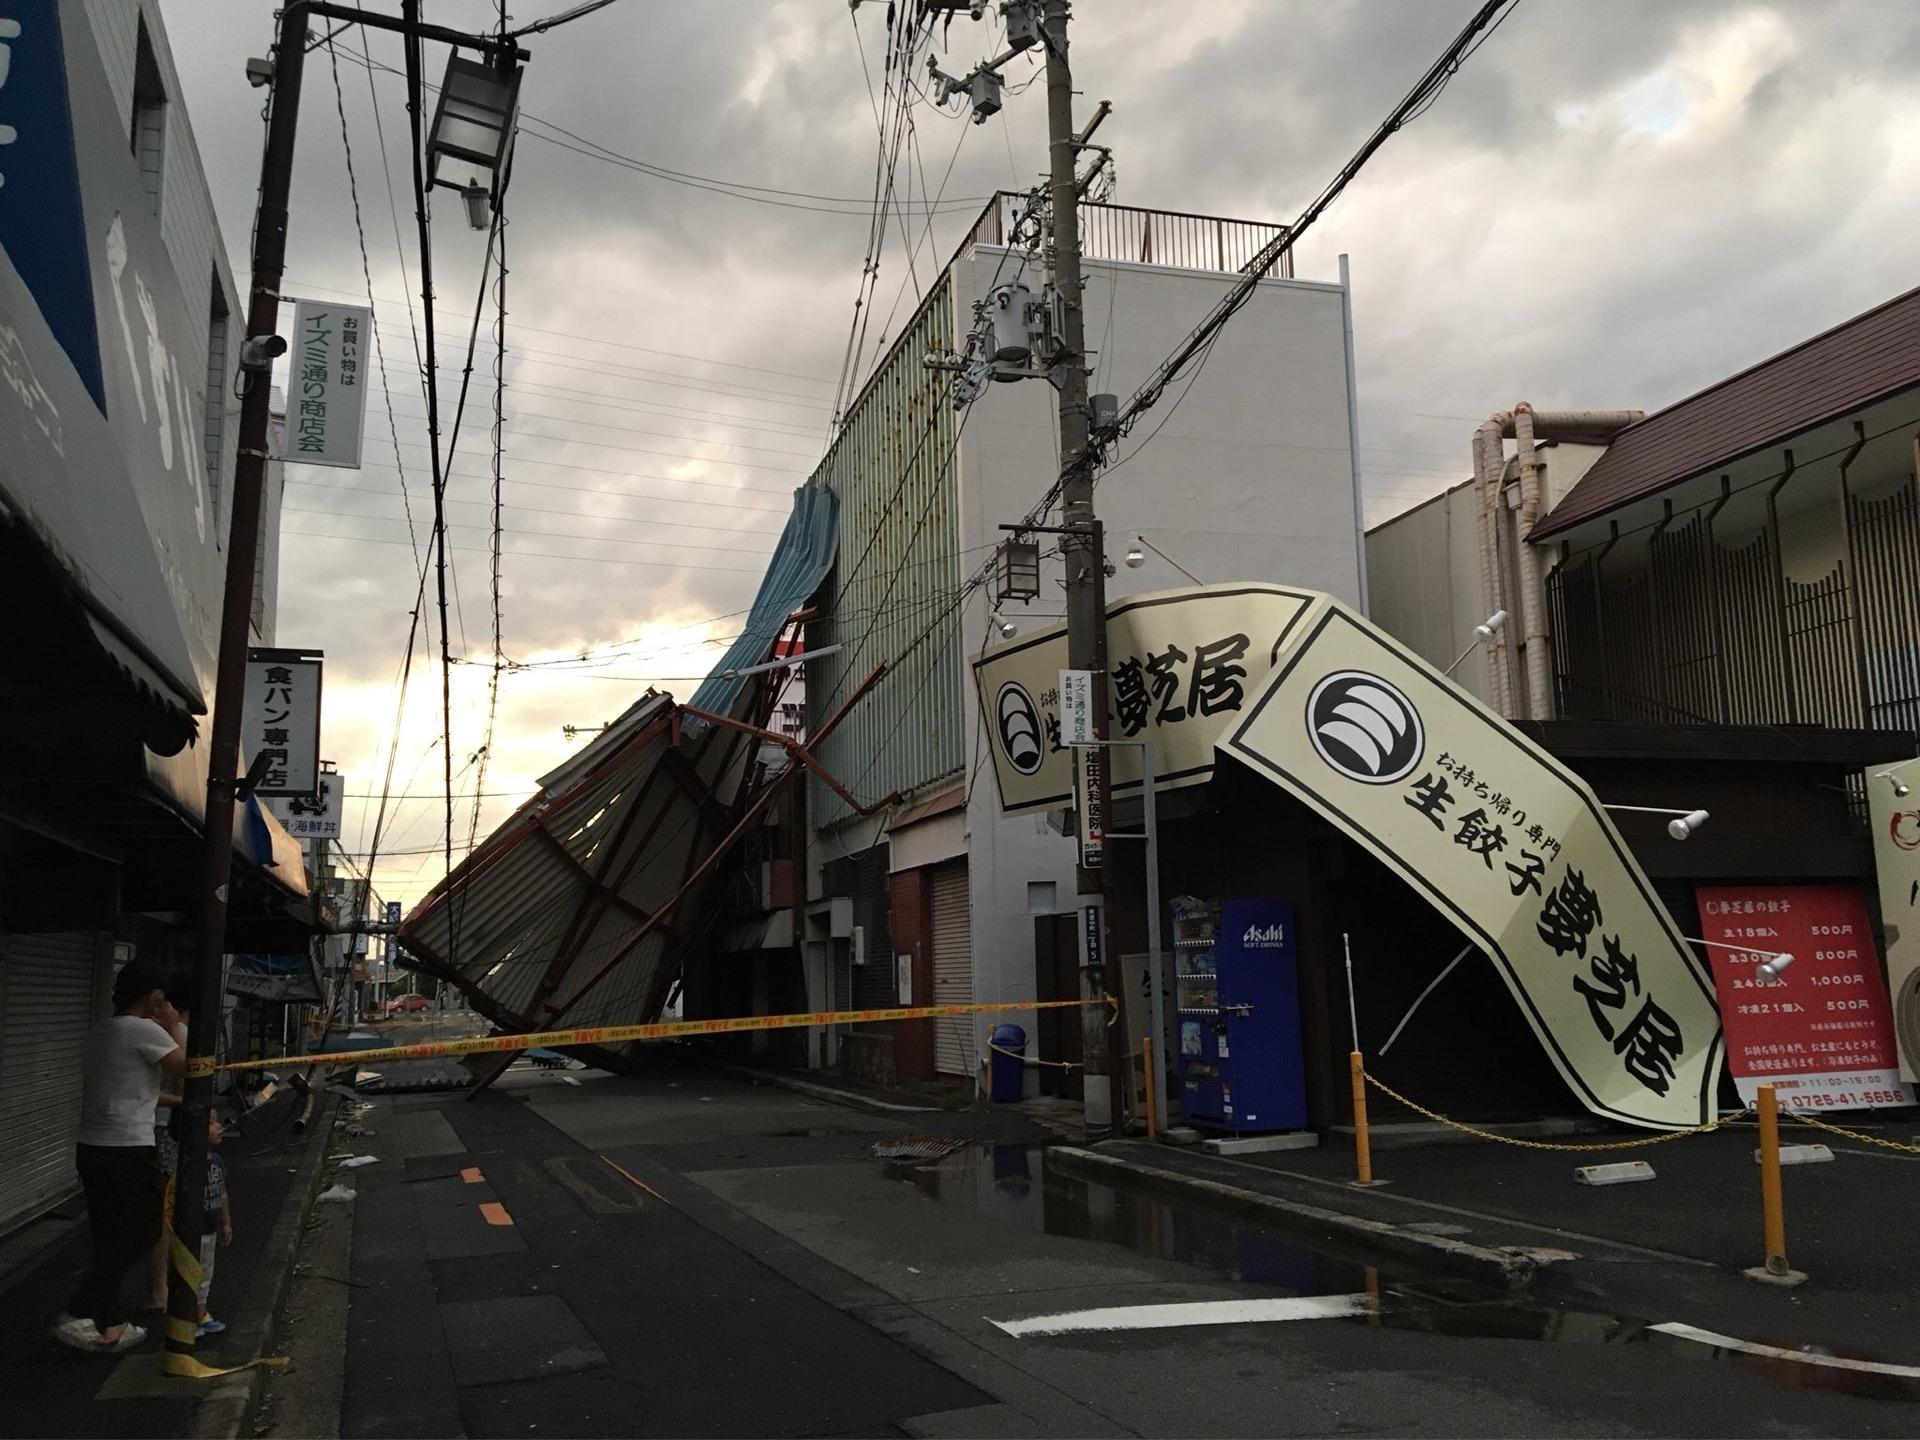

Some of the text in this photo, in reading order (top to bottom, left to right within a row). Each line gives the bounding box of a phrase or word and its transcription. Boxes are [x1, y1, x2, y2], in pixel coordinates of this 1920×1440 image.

[340, 317, 358, 386] お買い物は
[298, 313, 332, 454] イズミ通り商店会
[1436, 751, 1562, 863] お持ち帰り専門
[1243, 924, 1283, 942] Asahi
[1811, 926, 1853, 936] 500円
[1728, 950, 1858, 964] 生30個 800円
[1811, 975, 1864, 985] 1,000円
[1827, 1000, 1870, 1010] 500円
[1792, 1090, 1904, 1108] 0725-41-5656
